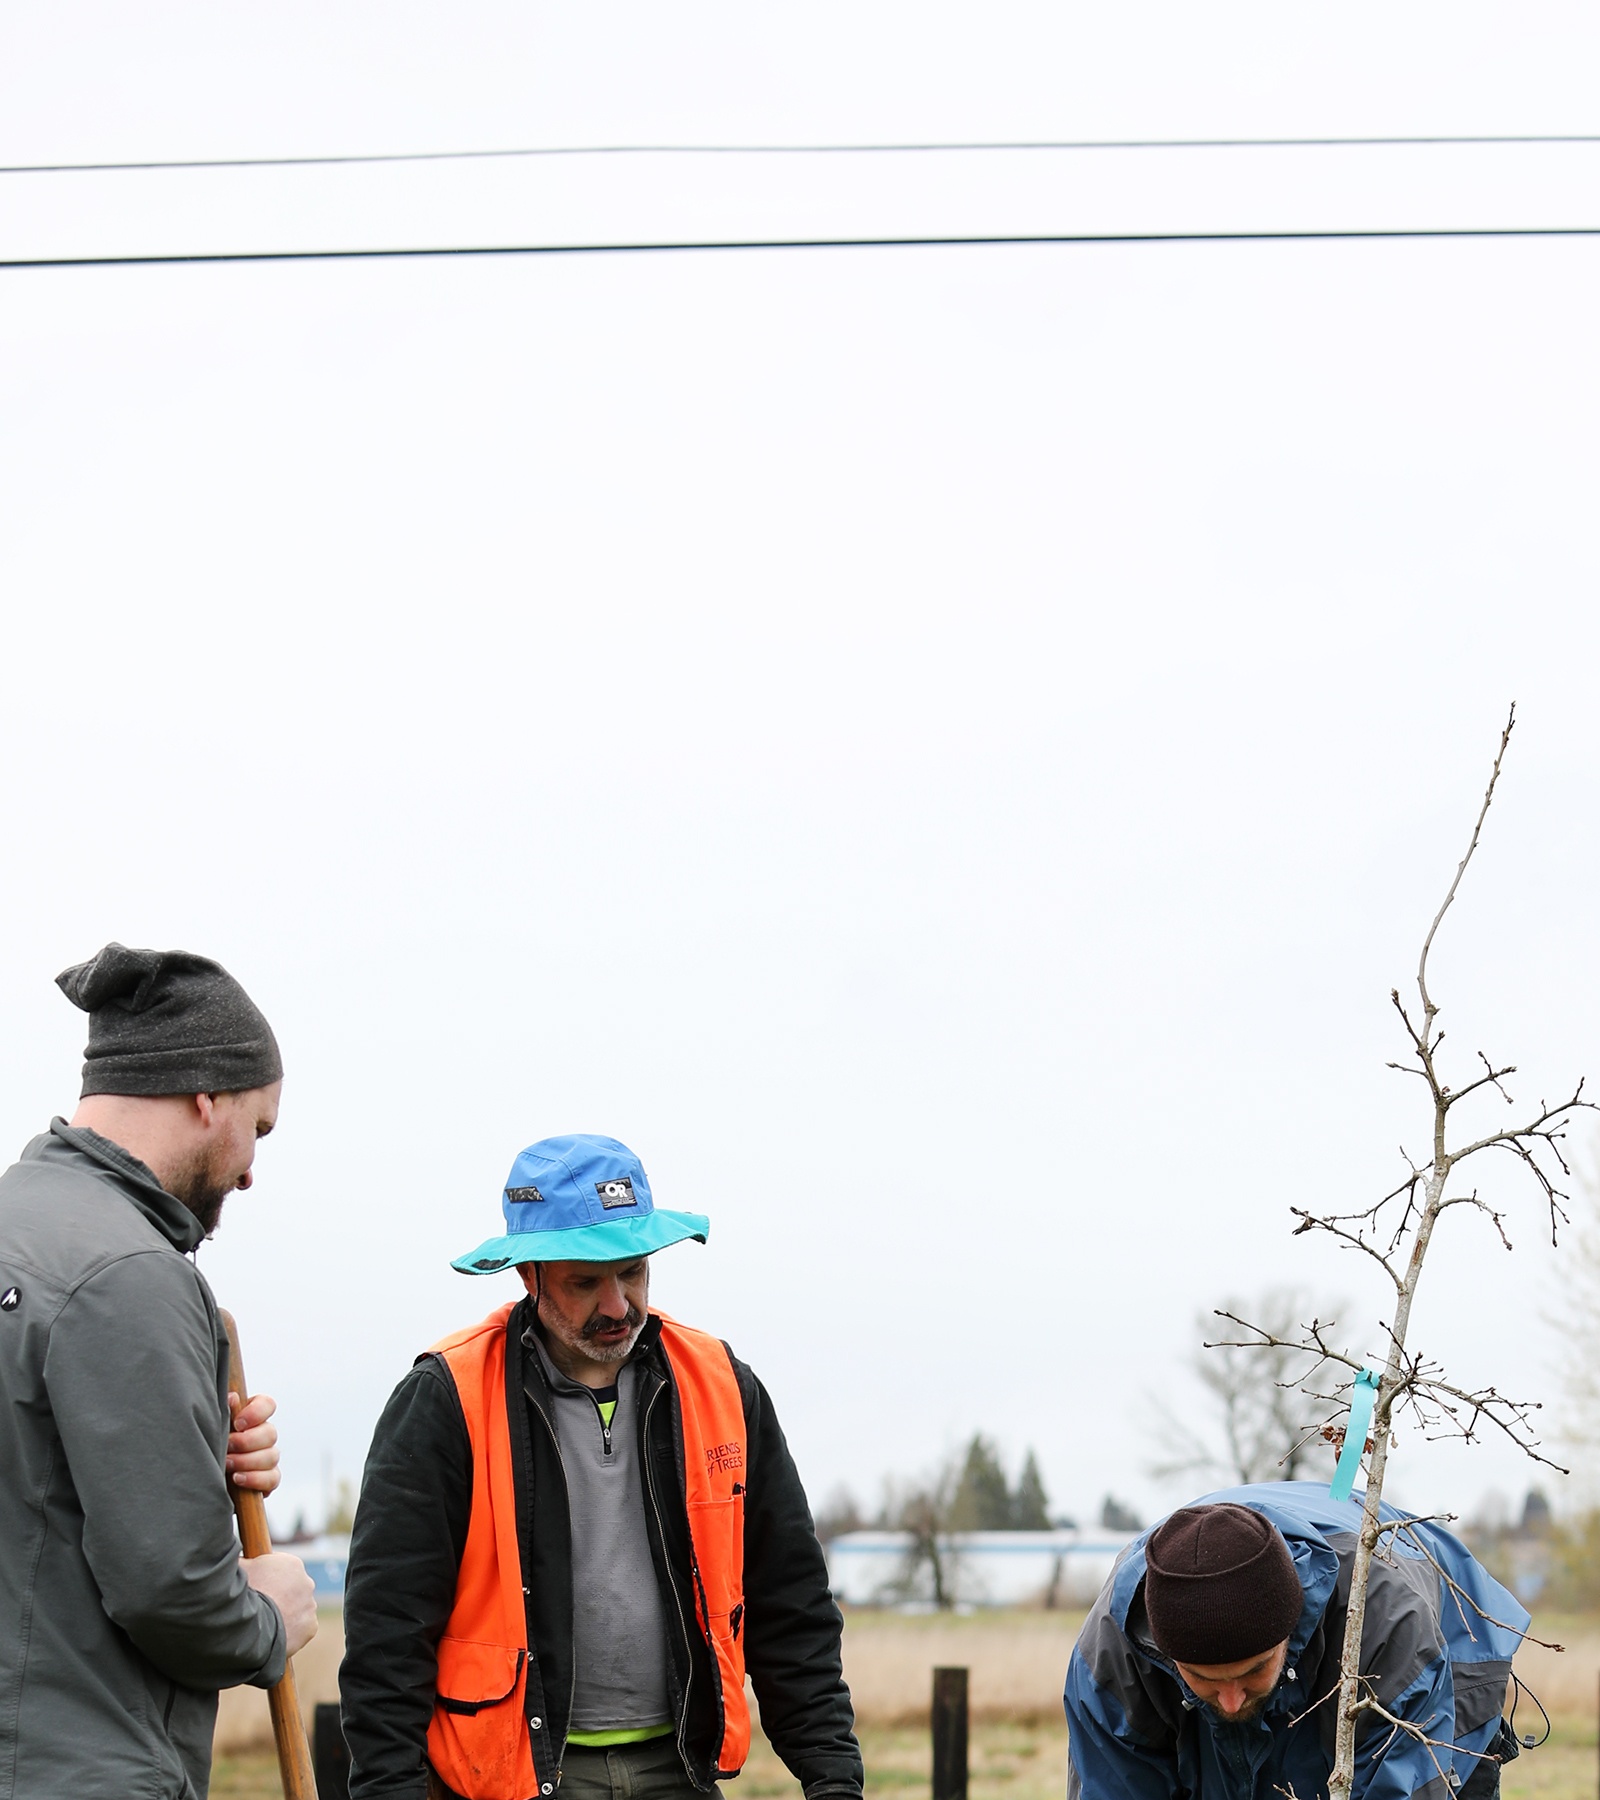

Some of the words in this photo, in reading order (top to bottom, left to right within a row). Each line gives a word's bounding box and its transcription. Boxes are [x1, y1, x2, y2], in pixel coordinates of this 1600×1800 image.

[605, 1182, 628, 1198] OR
[705, 1442, 741, 1461] RIENDS
[716, 1456, 742, 1473] TREES
